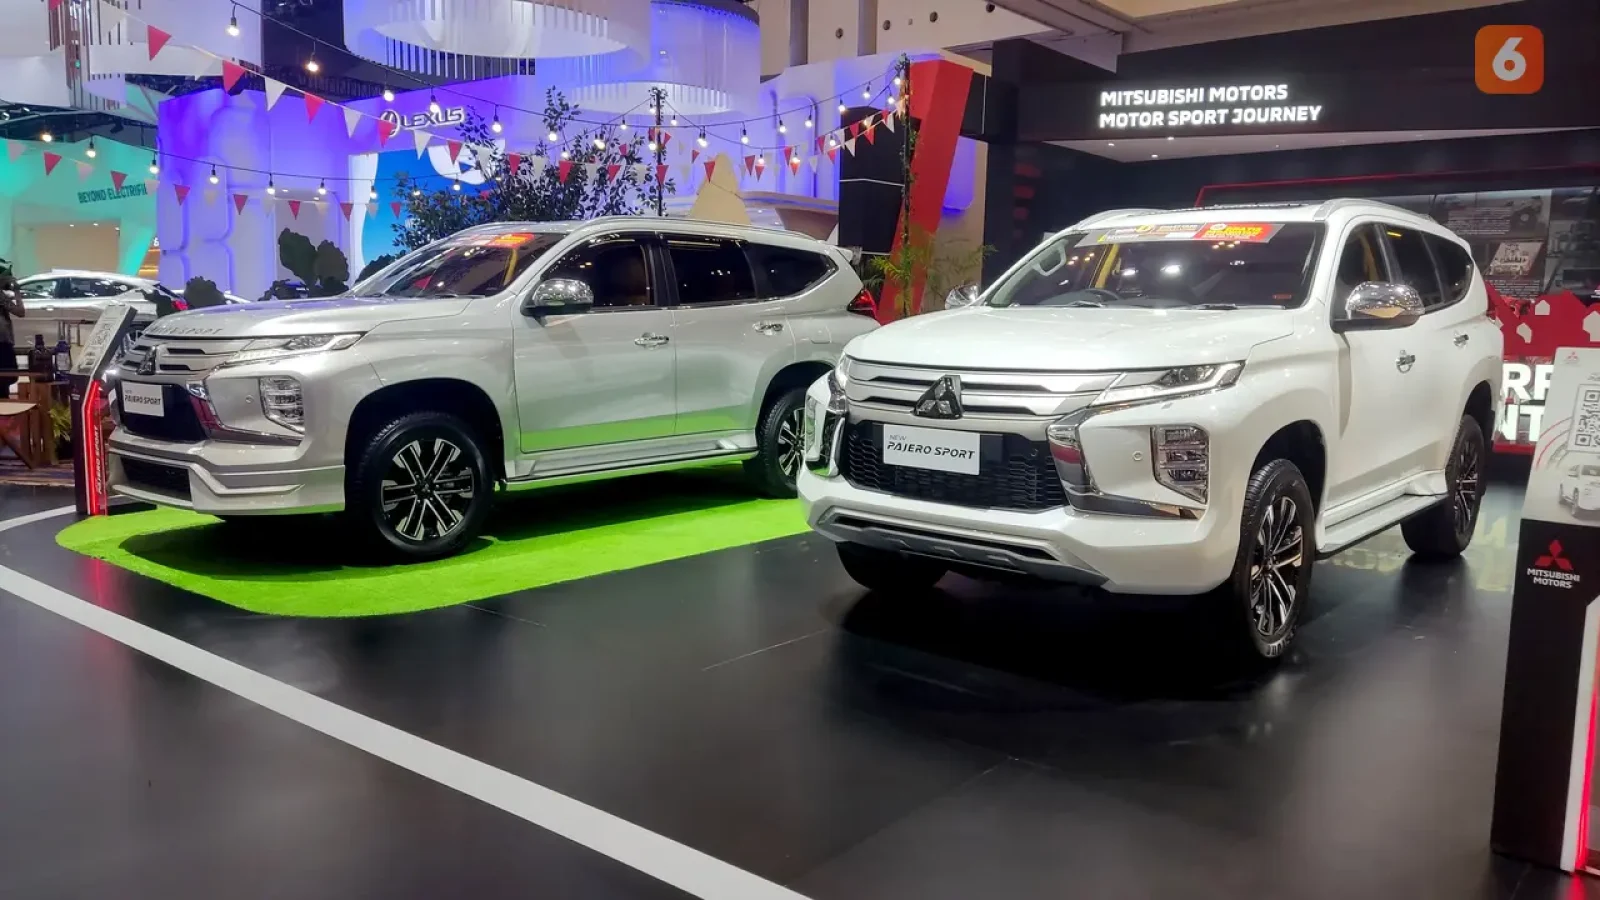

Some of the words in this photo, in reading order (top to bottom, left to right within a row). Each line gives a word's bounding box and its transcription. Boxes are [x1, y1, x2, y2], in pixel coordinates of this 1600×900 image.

[1100, 88, 1204, 107] MITSUBISHI
[1209, 84, 1288, 102] MOTORS
[400, 107, 465, 130] LEXUS
[1099, 112, 1164, 128] MOTOR
[1168, 109, 1228, 126] SPORT
[1231, 105, 1322, 124] JOURNEY
[78, 190, 107, 204] BEYOND
[887, 441, 932, 455] PAJERO
[934, 446, 975, 460] SPORT
[1527, 568, 1580, 582] MITSUBISHI
[1533, 577, 1573, 589] MOTORS
